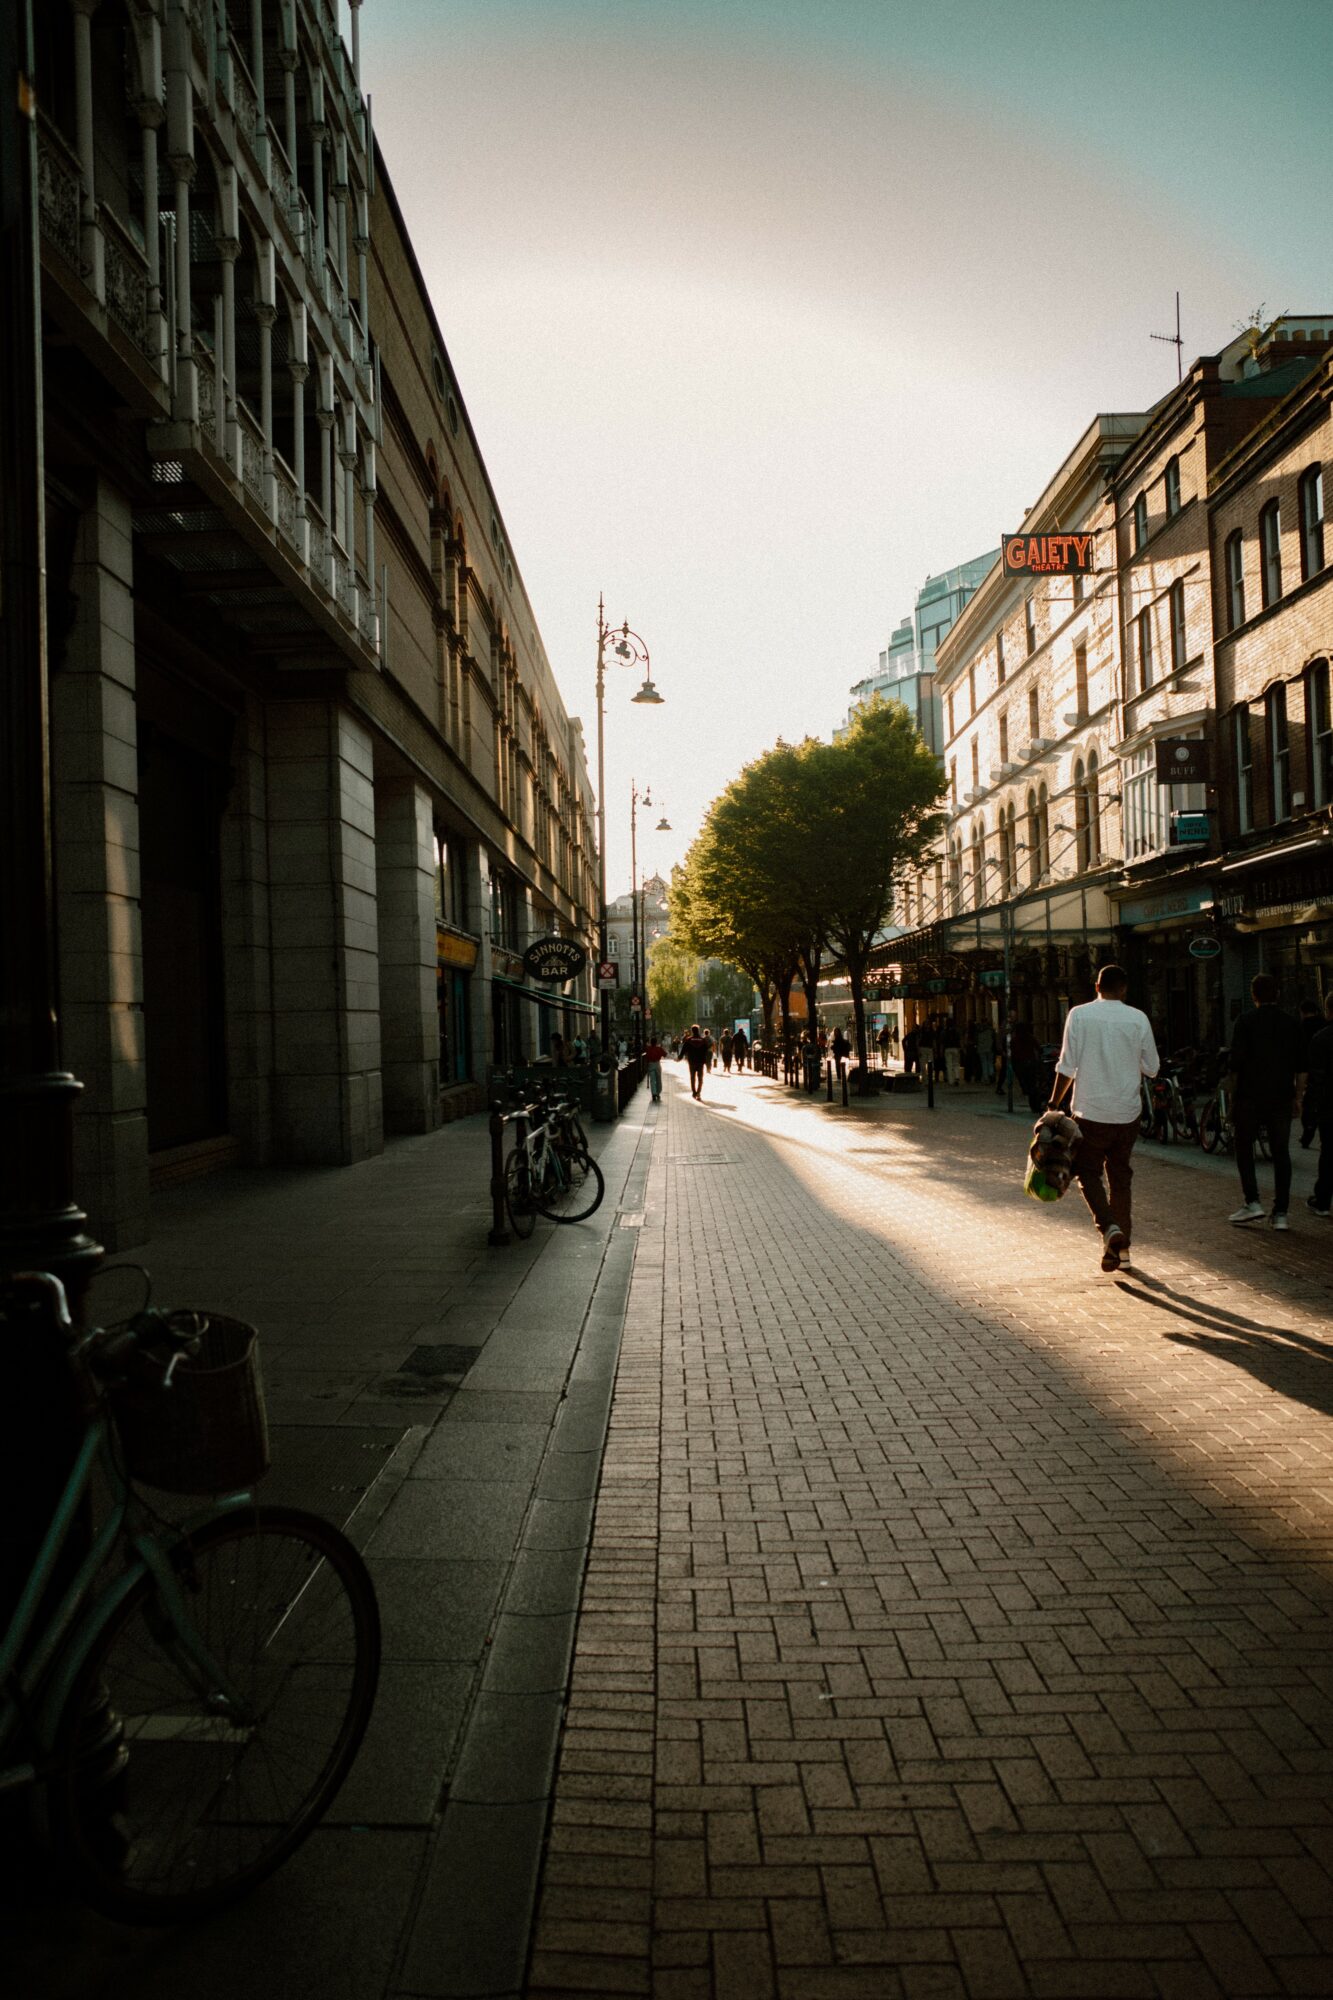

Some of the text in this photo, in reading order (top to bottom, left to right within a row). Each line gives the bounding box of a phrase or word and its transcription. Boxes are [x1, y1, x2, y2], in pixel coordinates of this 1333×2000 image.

[1006, 536, 1090, 569] GAIETY
[1032, 563, 1065, 572] THEATRE
[1170, 767, 1196, 775] BUFF
[1221, 895, 1245, 917] BUFF
[1255, 907, 1270, 919] GIFTS
[1270, 903, 1292, 916] BEYOND
[529, 943, 581, 964] SINNOTTS
[541, 967, 569, 976] BAR
